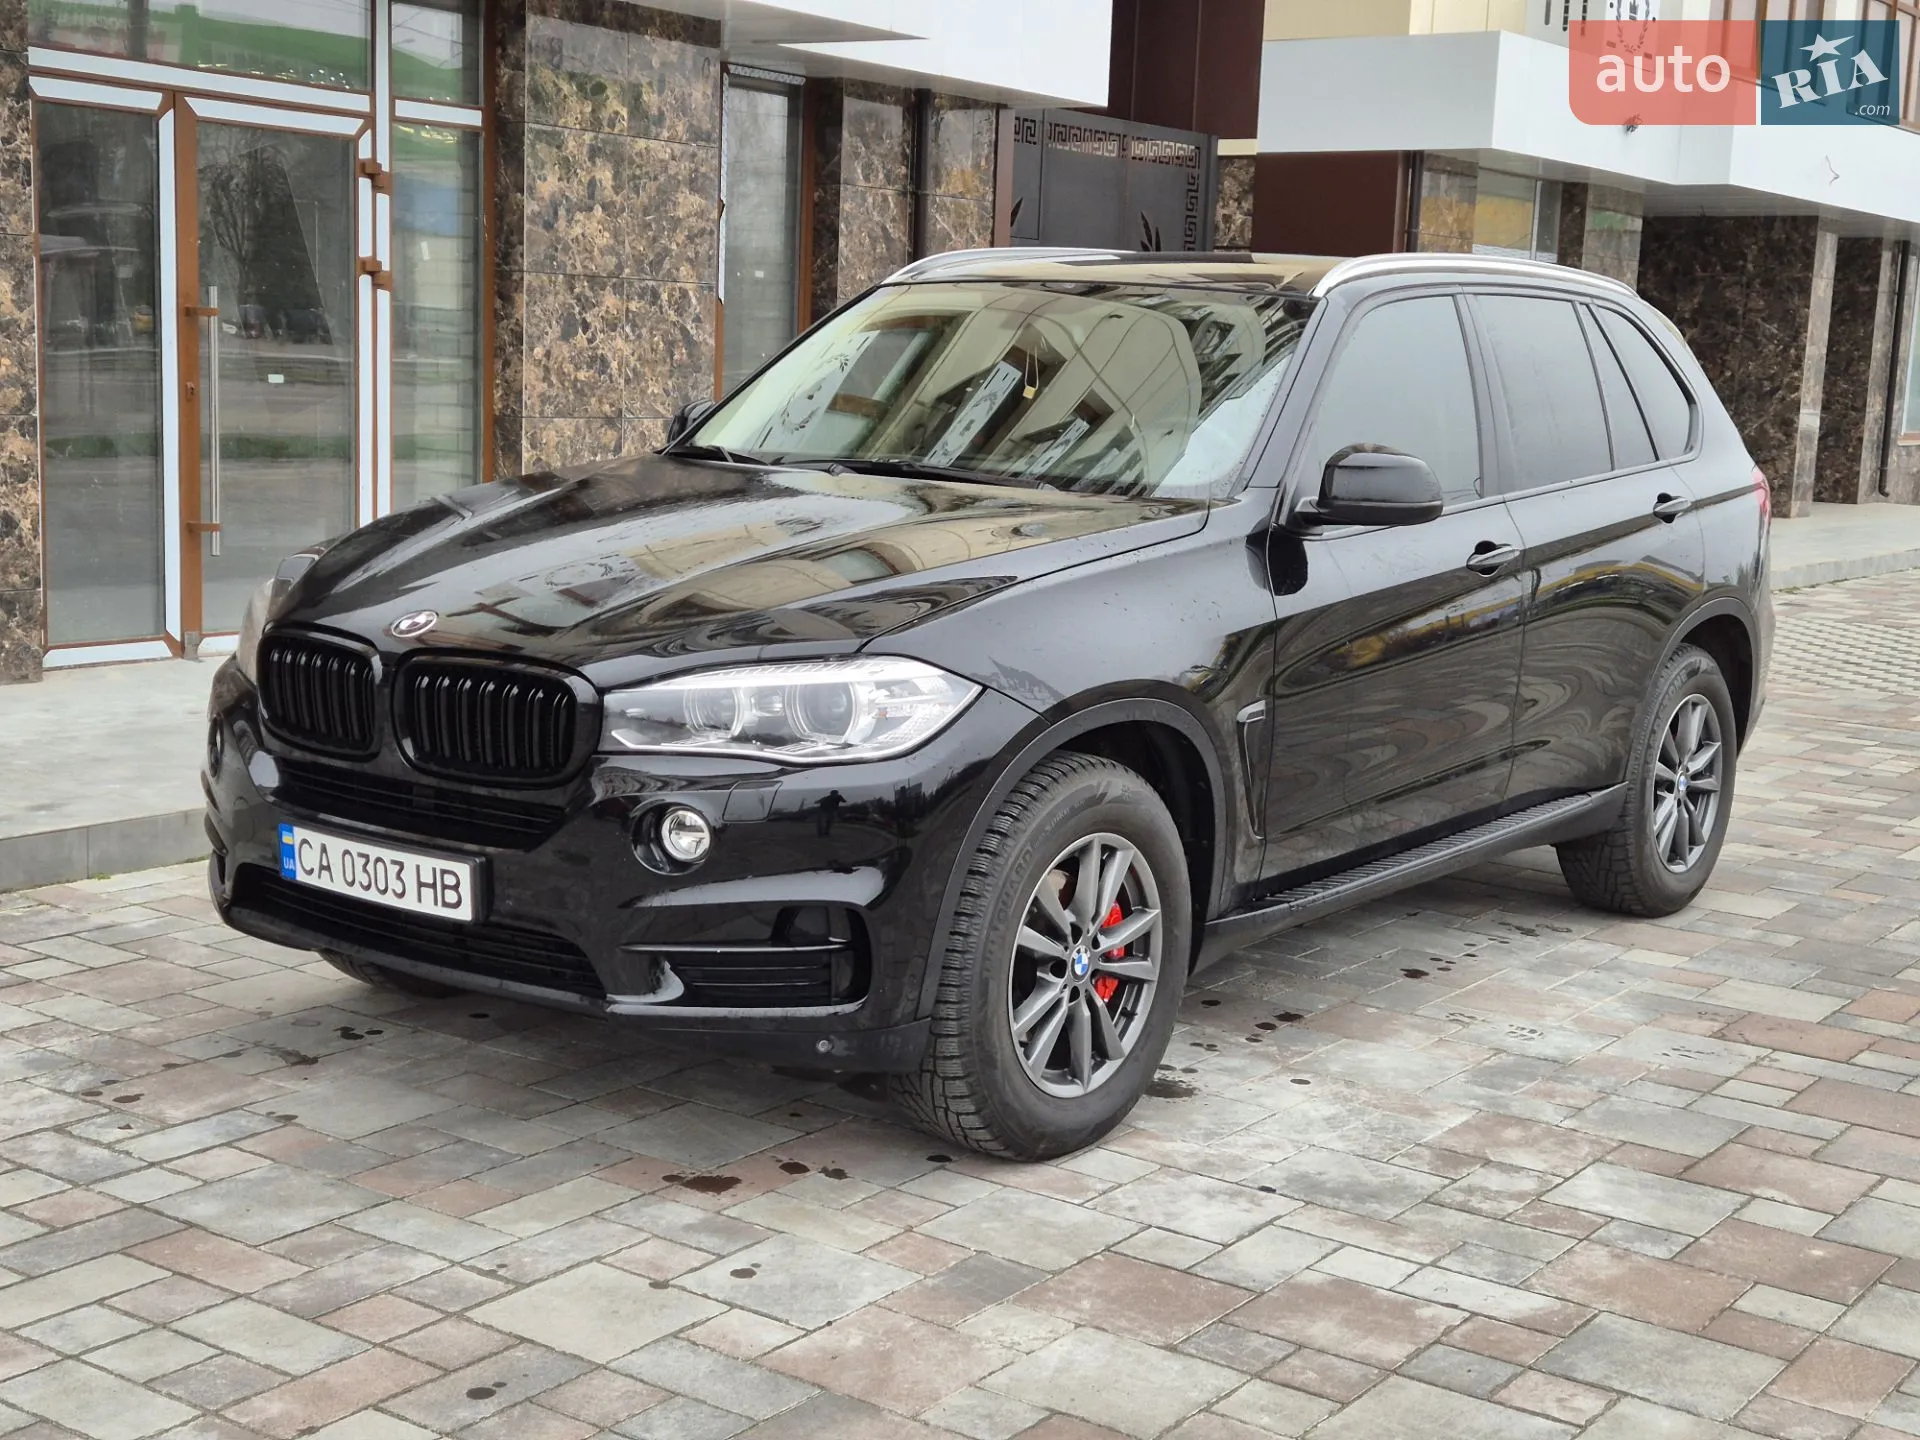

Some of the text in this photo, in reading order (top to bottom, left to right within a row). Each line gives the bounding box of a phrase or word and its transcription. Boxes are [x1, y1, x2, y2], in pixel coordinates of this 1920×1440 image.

[283, 858, 295, 870] UA
[298, 838, 462, 909] CA 0303 HB
